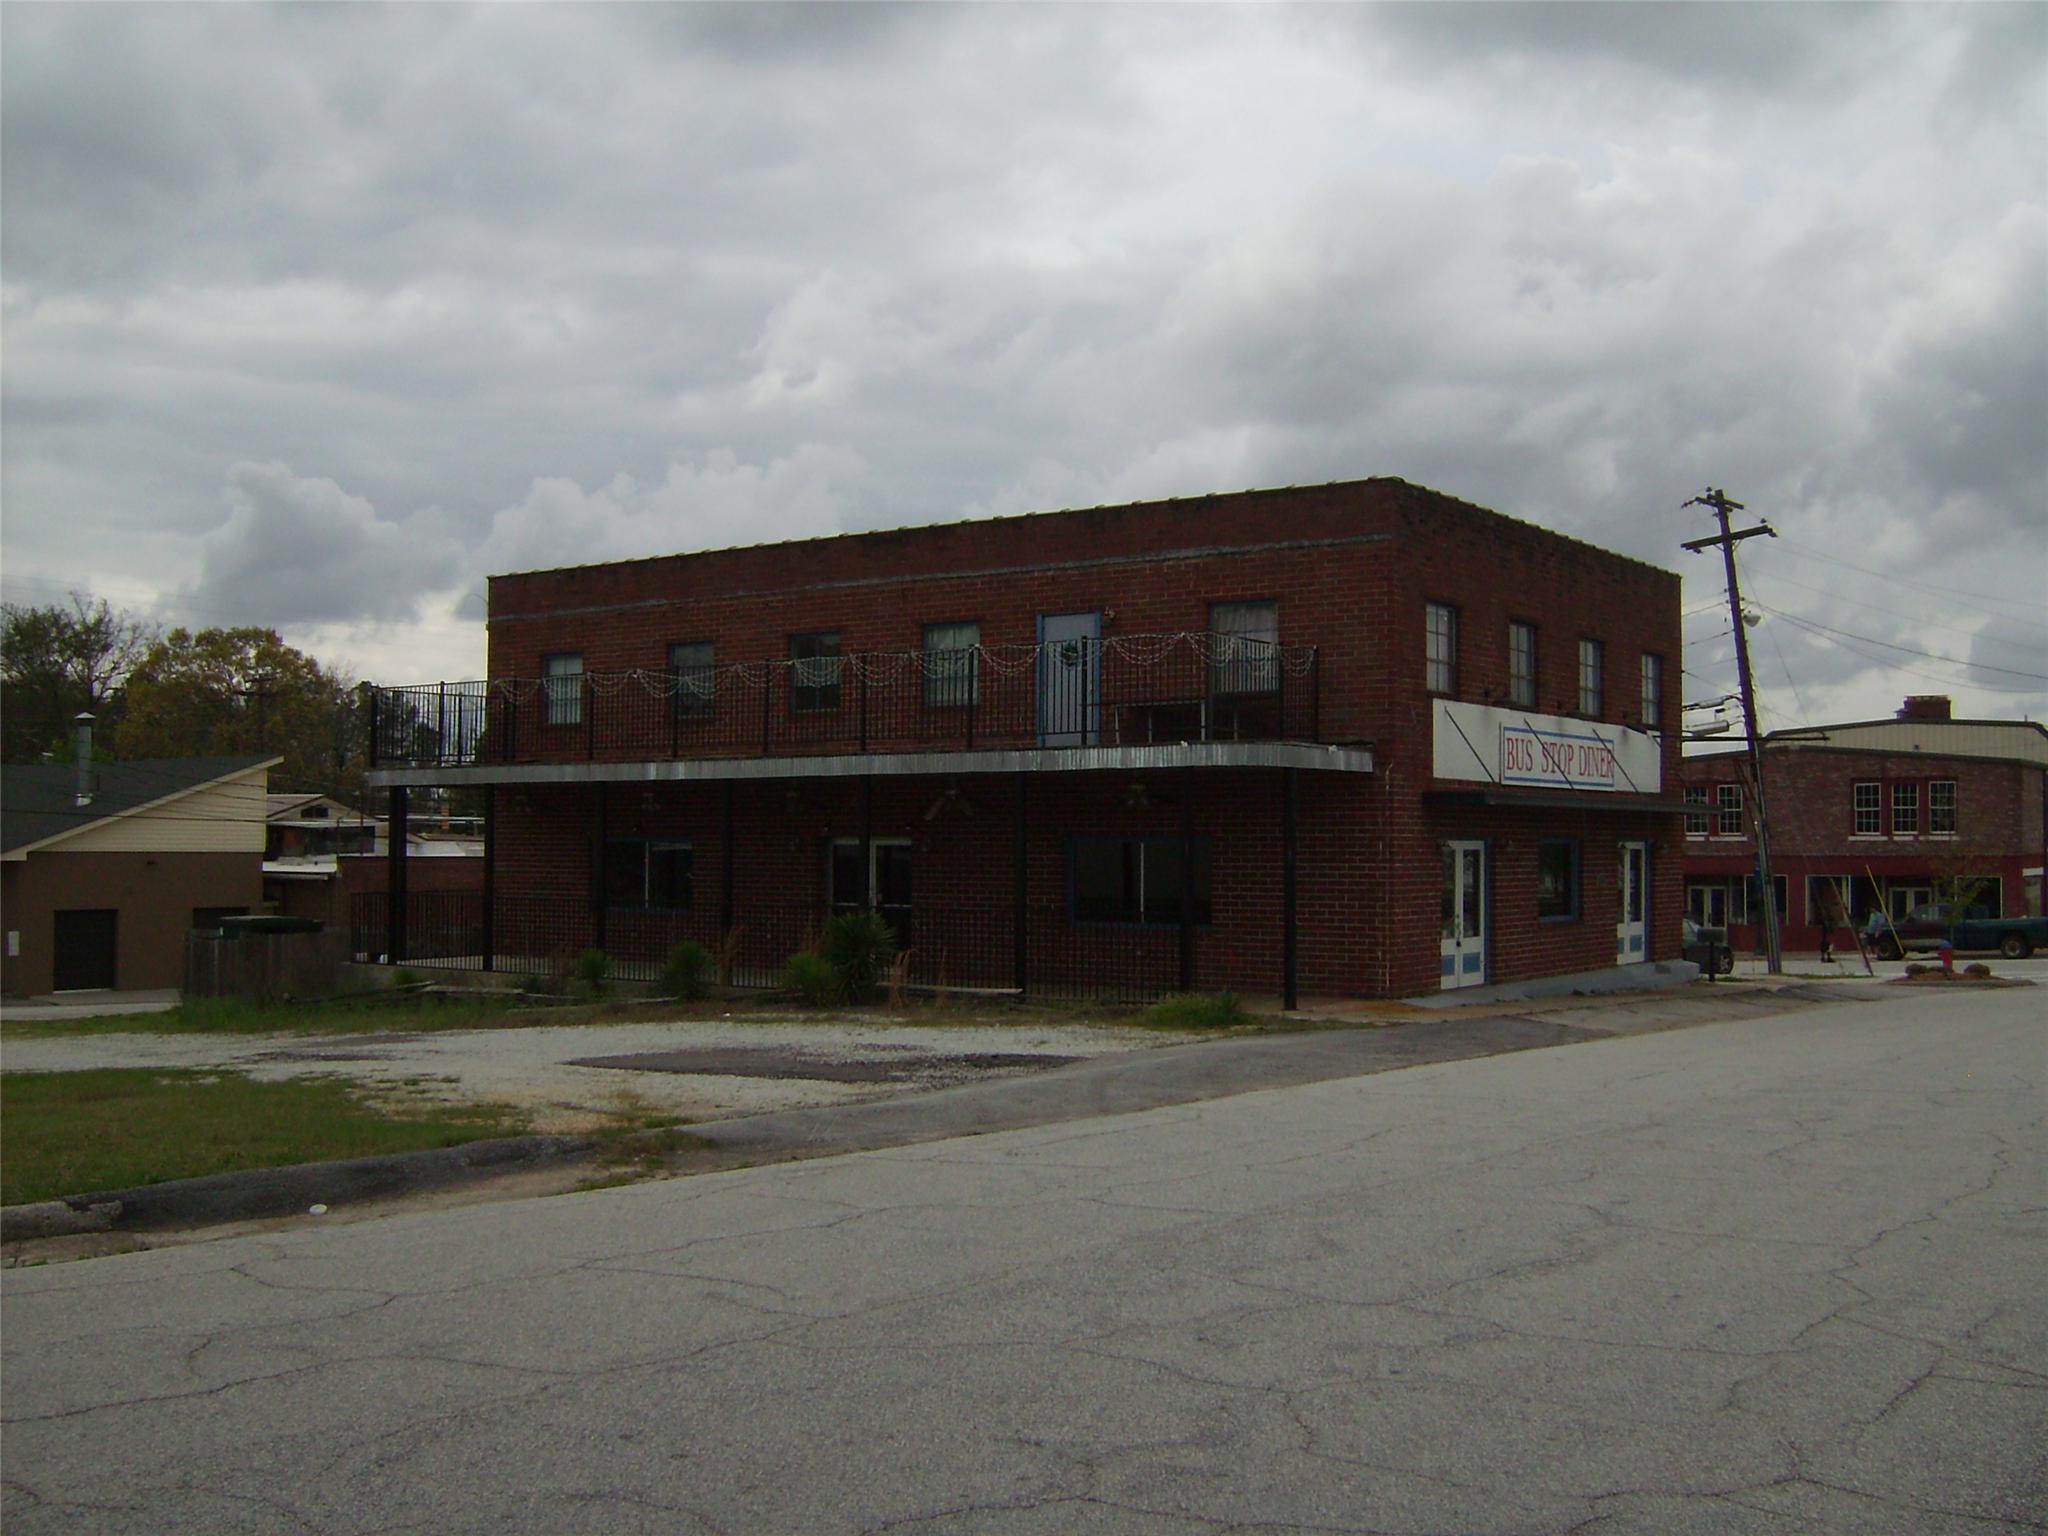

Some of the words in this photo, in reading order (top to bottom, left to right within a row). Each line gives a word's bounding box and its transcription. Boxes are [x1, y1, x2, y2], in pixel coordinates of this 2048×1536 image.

[1506, 737, 1533, 772] BUS
[1541, 741, 1574, 776] STOP
[1578, 745, 1614, 779] DINER
